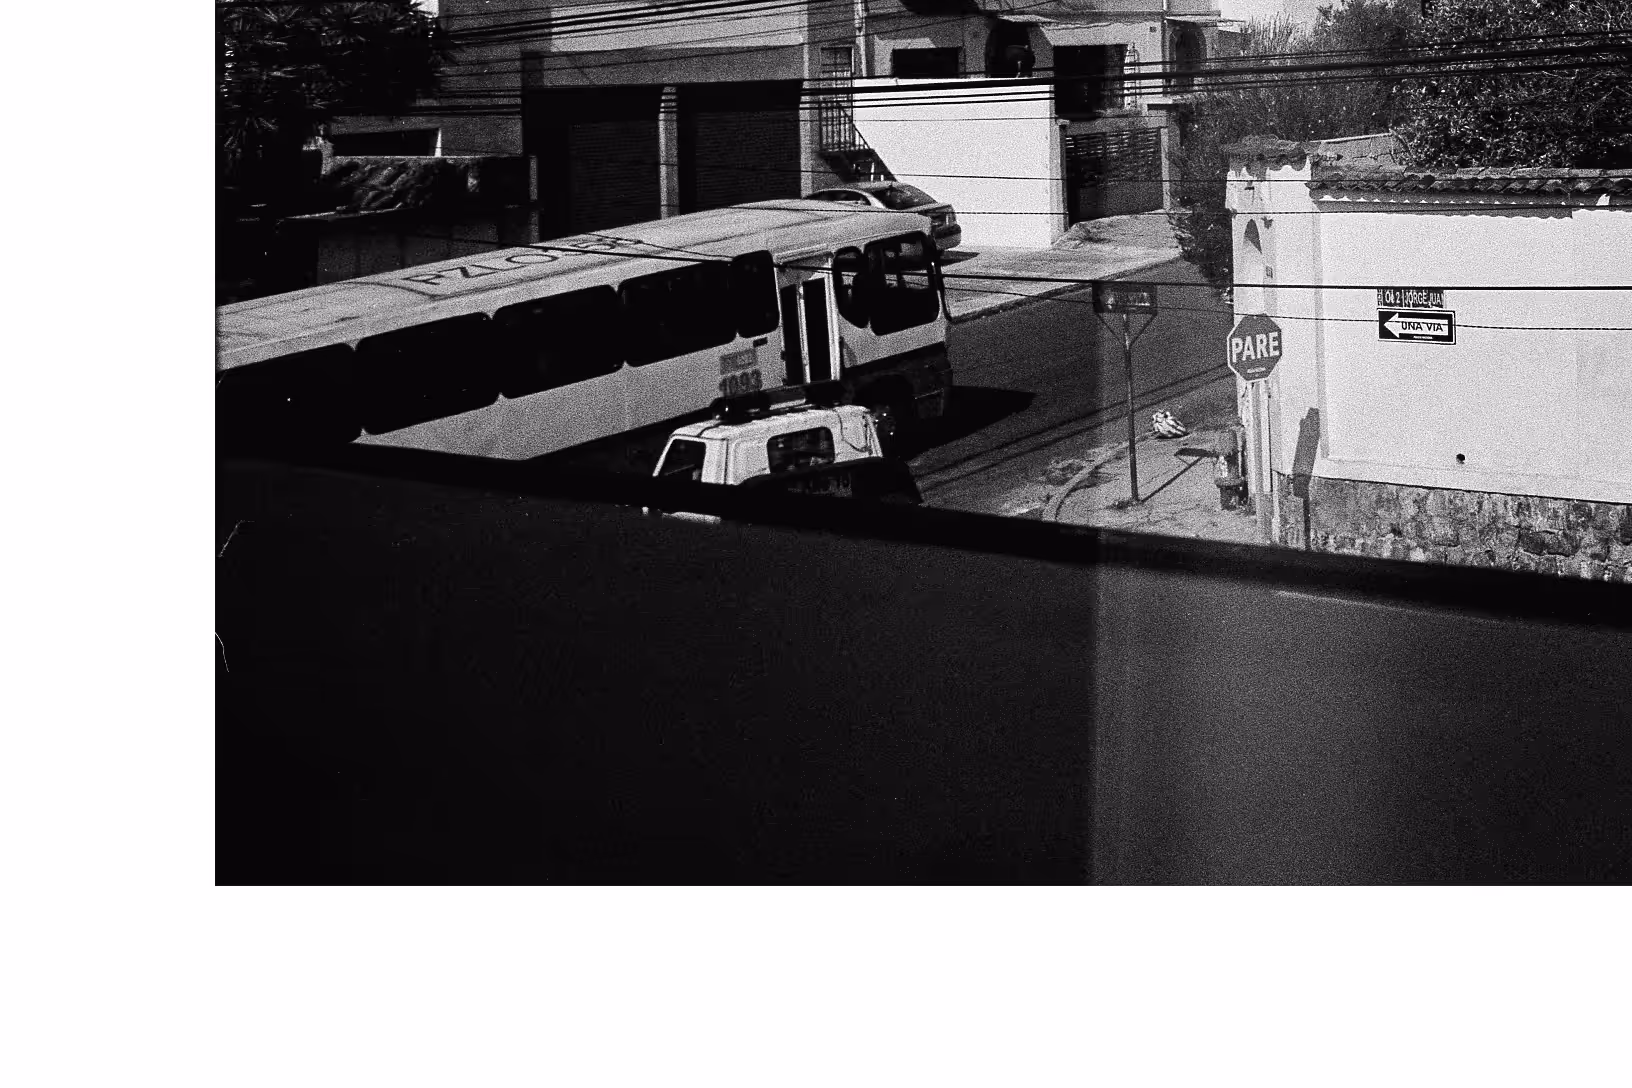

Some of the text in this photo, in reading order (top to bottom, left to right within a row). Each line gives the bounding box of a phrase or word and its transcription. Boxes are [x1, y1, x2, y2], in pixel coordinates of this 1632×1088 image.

[1405, 291, 1428, 305] JORGE
[1401, 321, 1444, 332] UNA VIA
[1231, 331, 1280, 363] PARE
